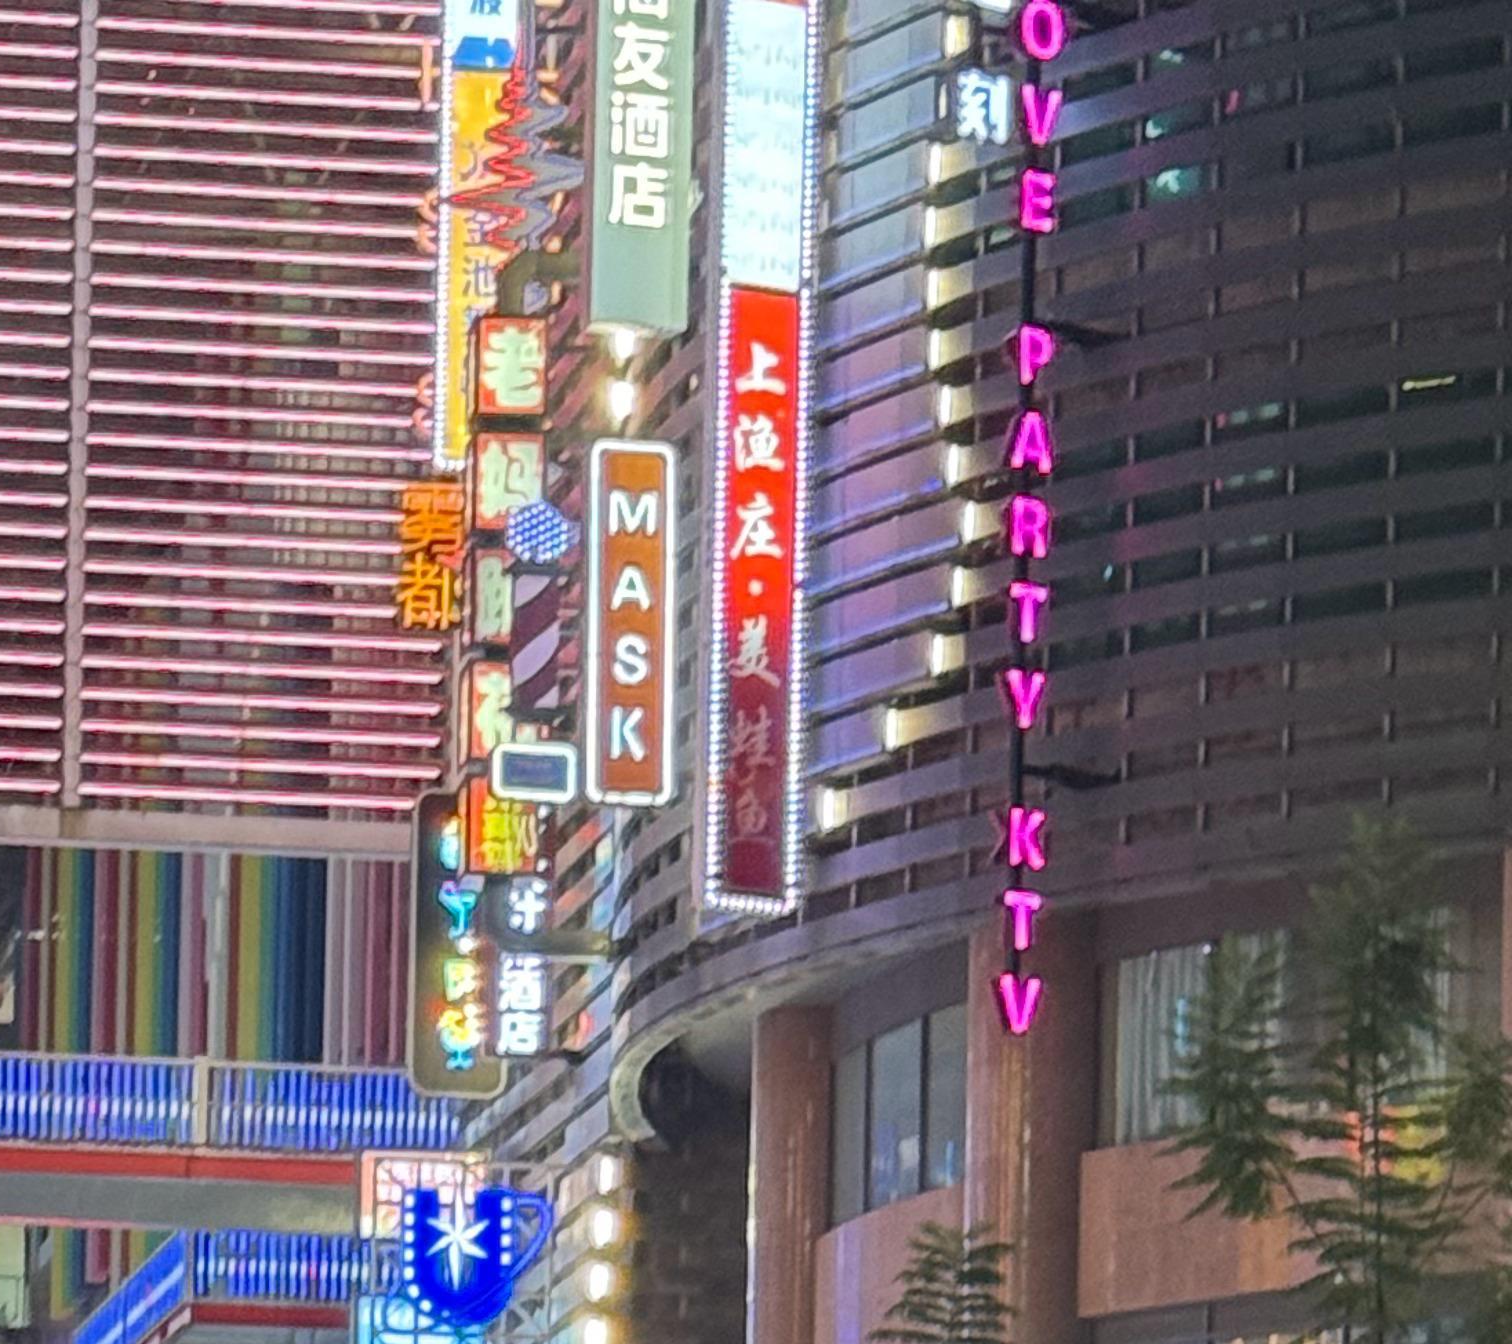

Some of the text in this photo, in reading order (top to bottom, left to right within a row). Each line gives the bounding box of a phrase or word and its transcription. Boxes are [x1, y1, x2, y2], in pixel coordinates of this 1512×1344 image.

[608, 490, 659, 763] MASK
[1005, 324, 1055, 731] PARTY
[999, 806, 1046, 1036] KTV
